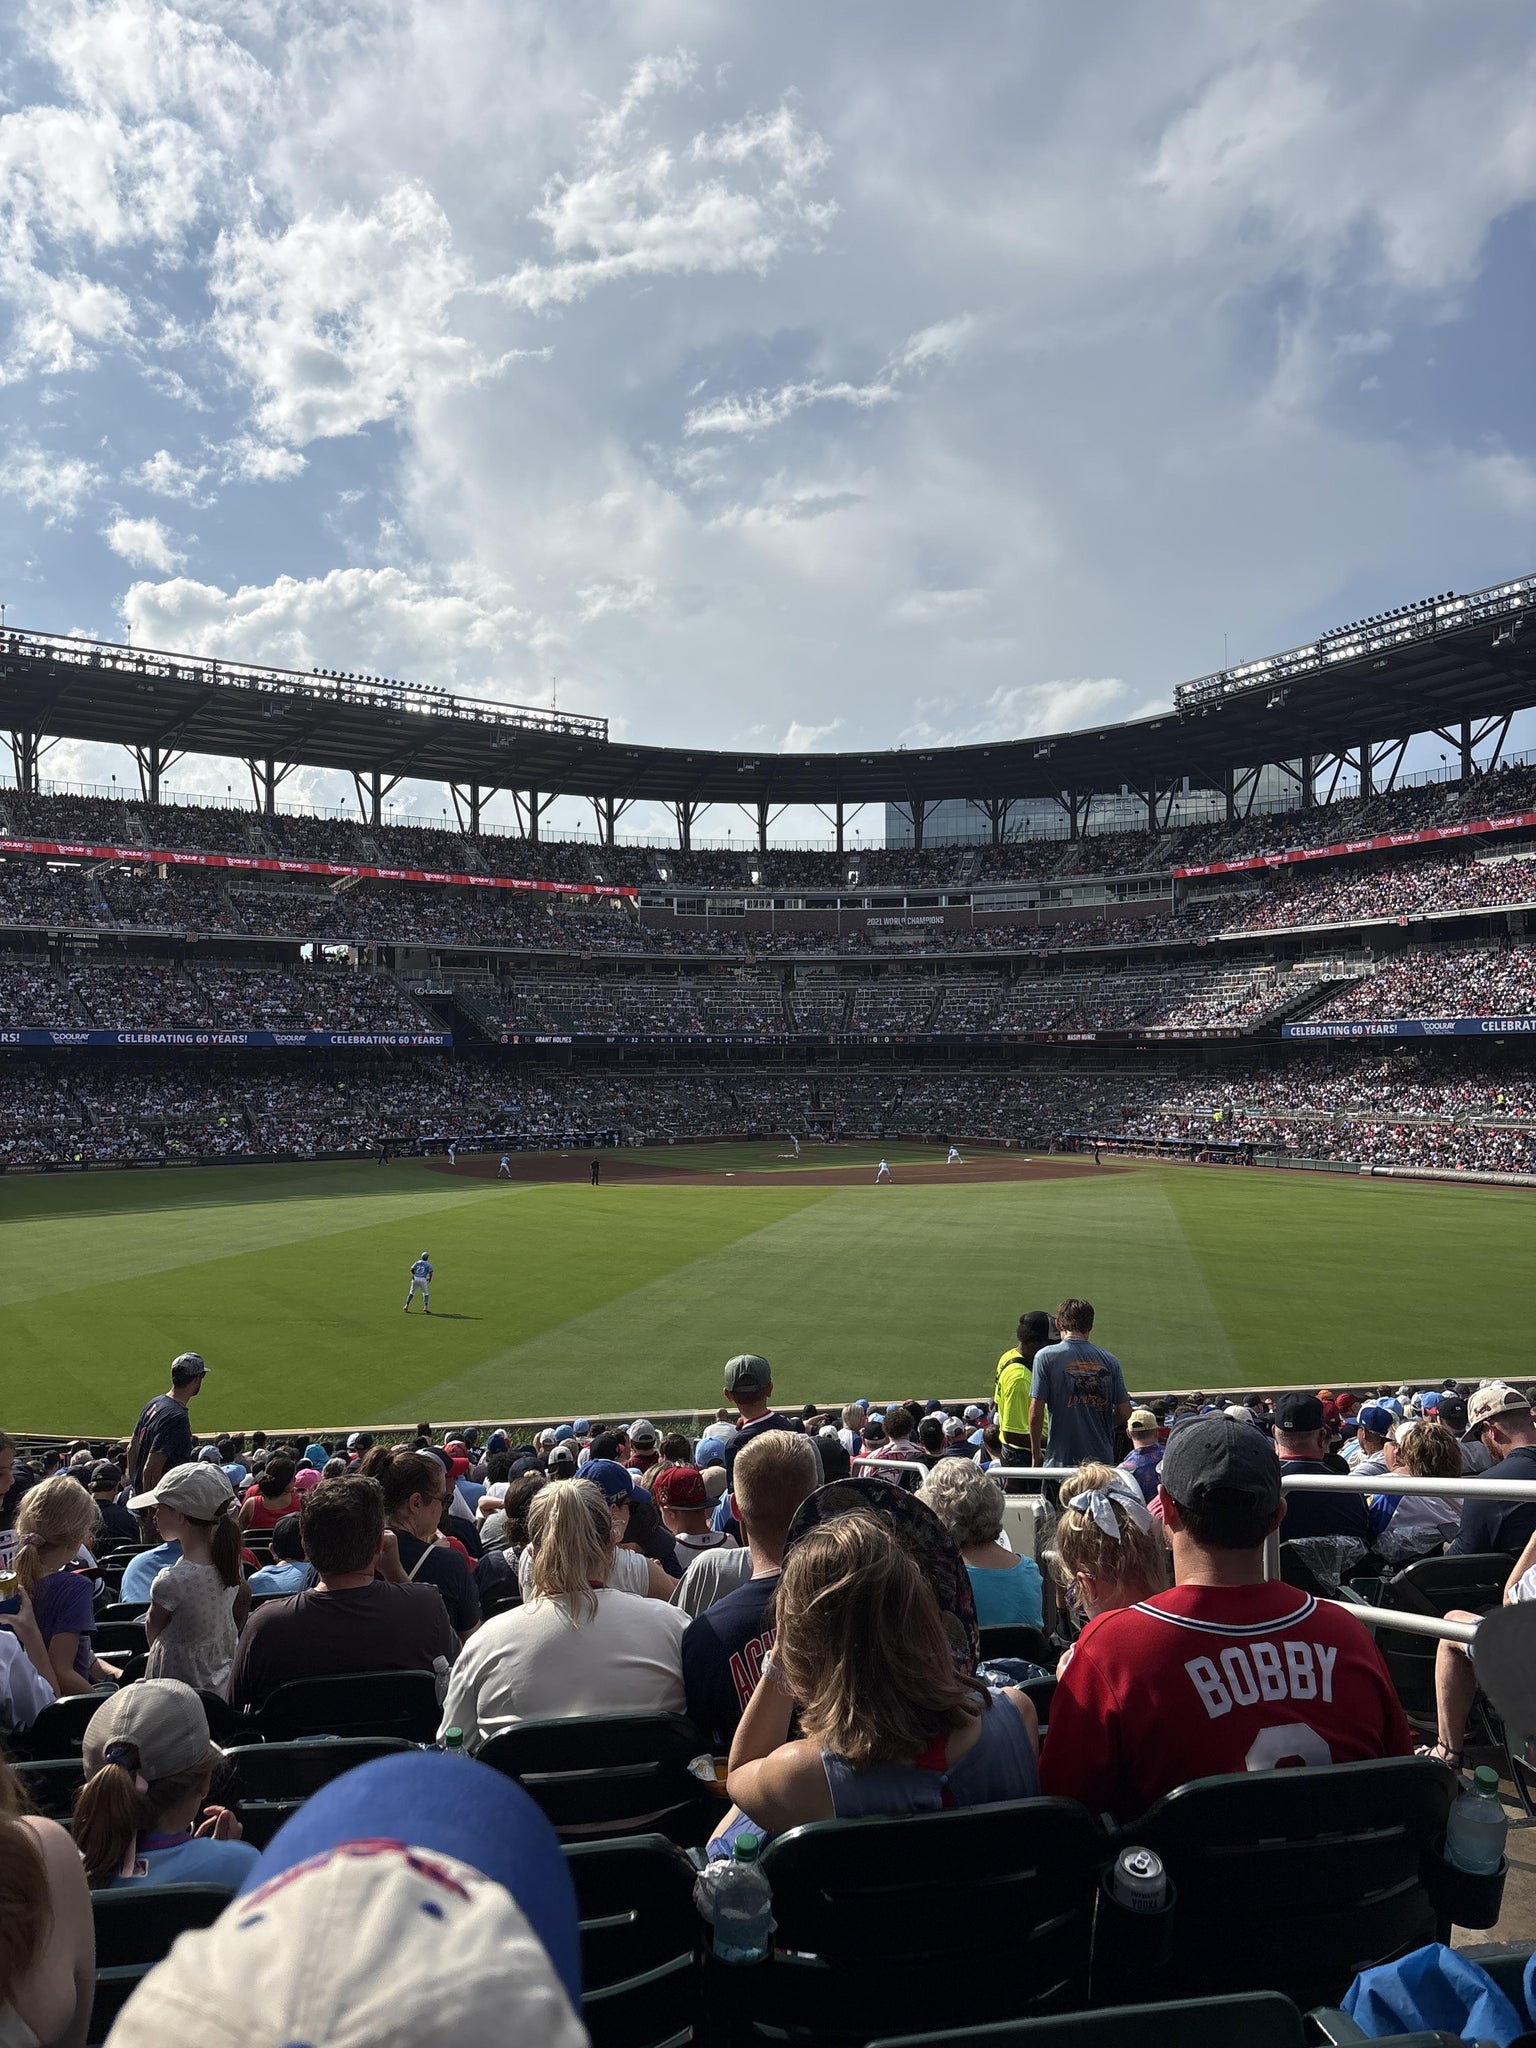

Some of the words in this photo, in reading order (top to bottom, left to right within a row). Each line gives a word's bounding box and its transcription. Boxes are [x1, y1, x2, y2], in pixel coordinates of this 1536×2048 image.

[866, 918, 882, 926] 2021
[907, 916, 944, 924] CHAMPIONS
[1290, 1026, 1350, 1036] CELEBRATING
[1352, 1026, 1362, 1034] 60
[1365, 1024, 1398, 1034] YEARS!
[1424, 1022, 1456, 1030] COOLRAY
[118, 1034, 193, 1043] CELEBRATING
[196, 1034, 208, 1043] 60
[211, 1034, 248, 1044] YEARS!
[330, 1036, 396, 1044] CELEBRATING
[398, 1036, 410, 1044] 60
[412, 1036, 443, 1044] YEARS!
[416, 1266, 425, 1274] 23
[1184, 1640, 1338, 1720] BOBBY
